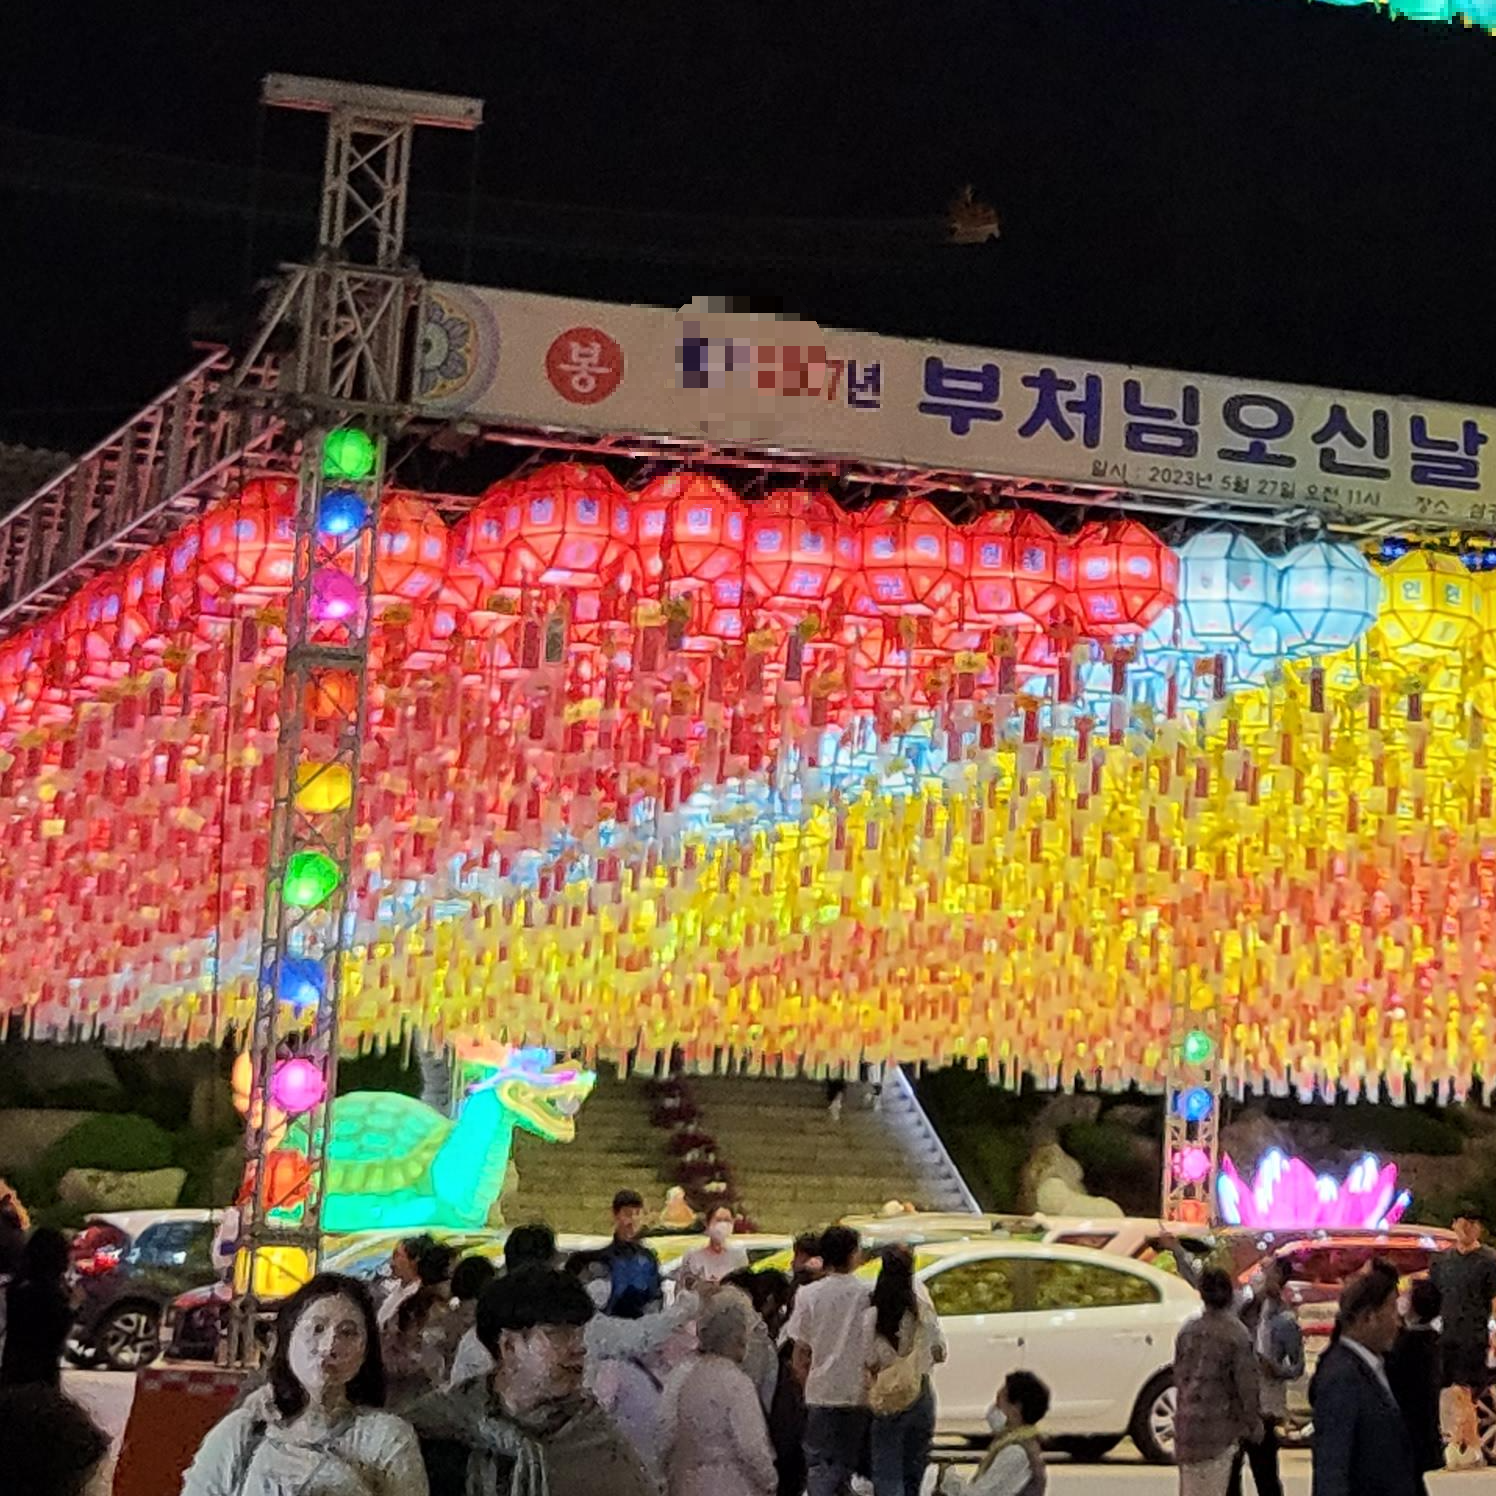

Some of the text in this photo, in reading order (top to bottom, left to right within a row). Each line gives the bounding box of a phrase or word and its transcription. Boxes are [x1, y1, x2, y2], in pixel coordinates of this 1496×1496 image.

[566, 338, 608, 394] 봉
[919, 355, 1490, 492] 부처님오신날
[1091, 459, 1128, 485] 일시
[1149, 466, 1213, 492] 2023년
[1220, 473, 1250, 496] 5월
[1257, 476, 1297, 500] 27일
[1346, 489, 1382, 508] 11시
[1415, 494, 1449, 516] 장소
